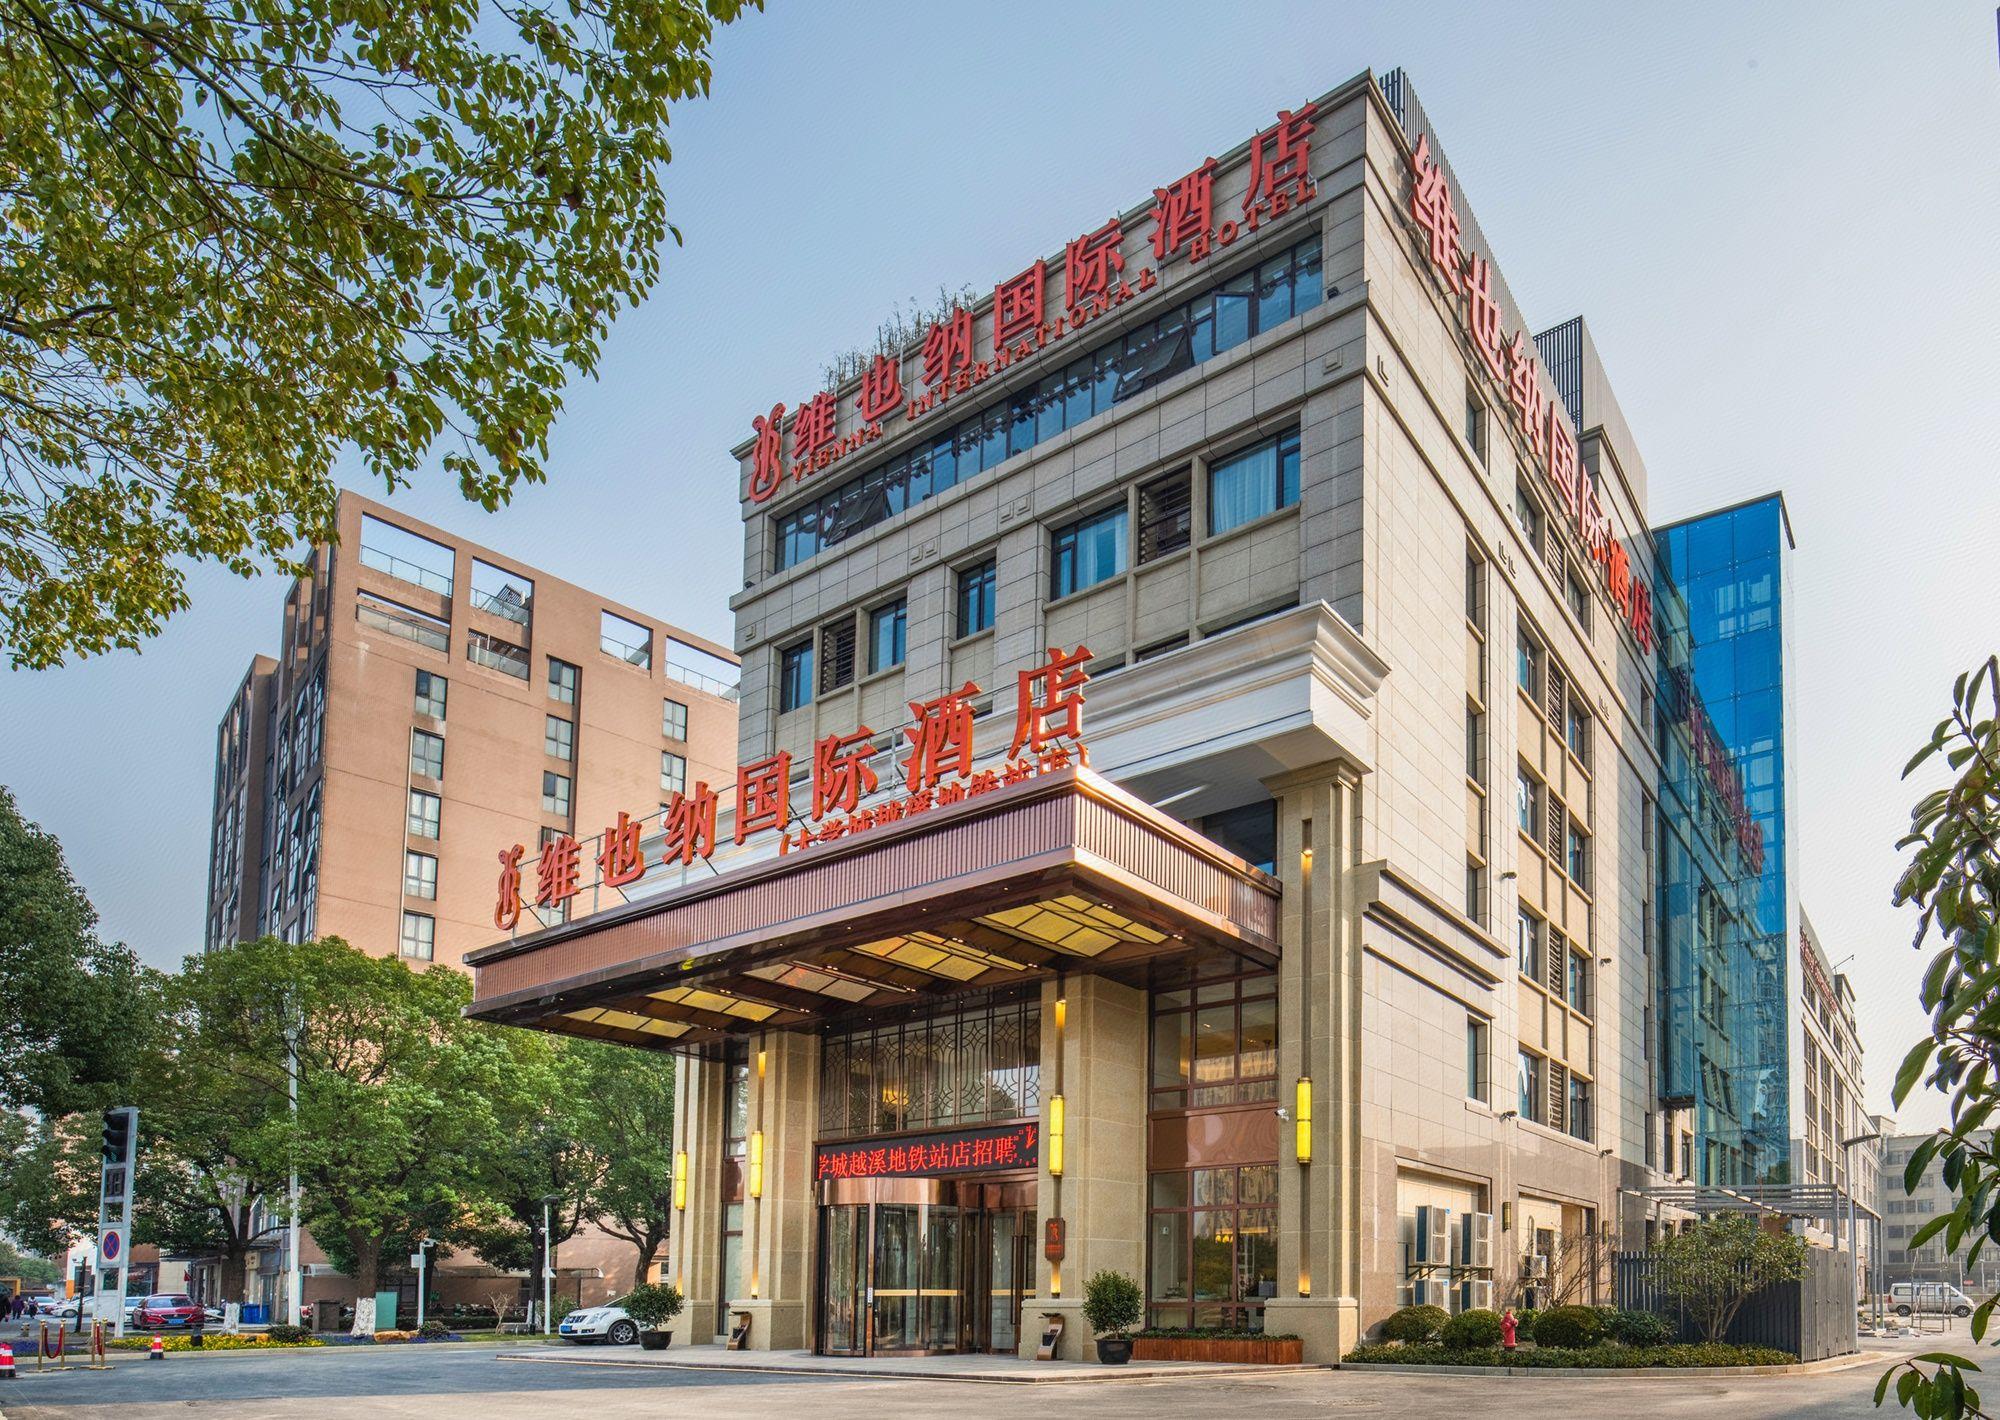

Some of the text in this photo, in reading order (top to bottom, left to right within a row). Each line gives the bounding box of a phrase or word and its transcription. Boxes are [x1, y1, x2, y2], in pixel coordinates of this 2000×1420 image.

[791, 101, 1319, 460] 维也纳国际酒店
[791, 179, 1318, 484] VIENNA INTERNATIONAL HOTEL
[535, 645, 1095, 908] 维也纳国际酒店
